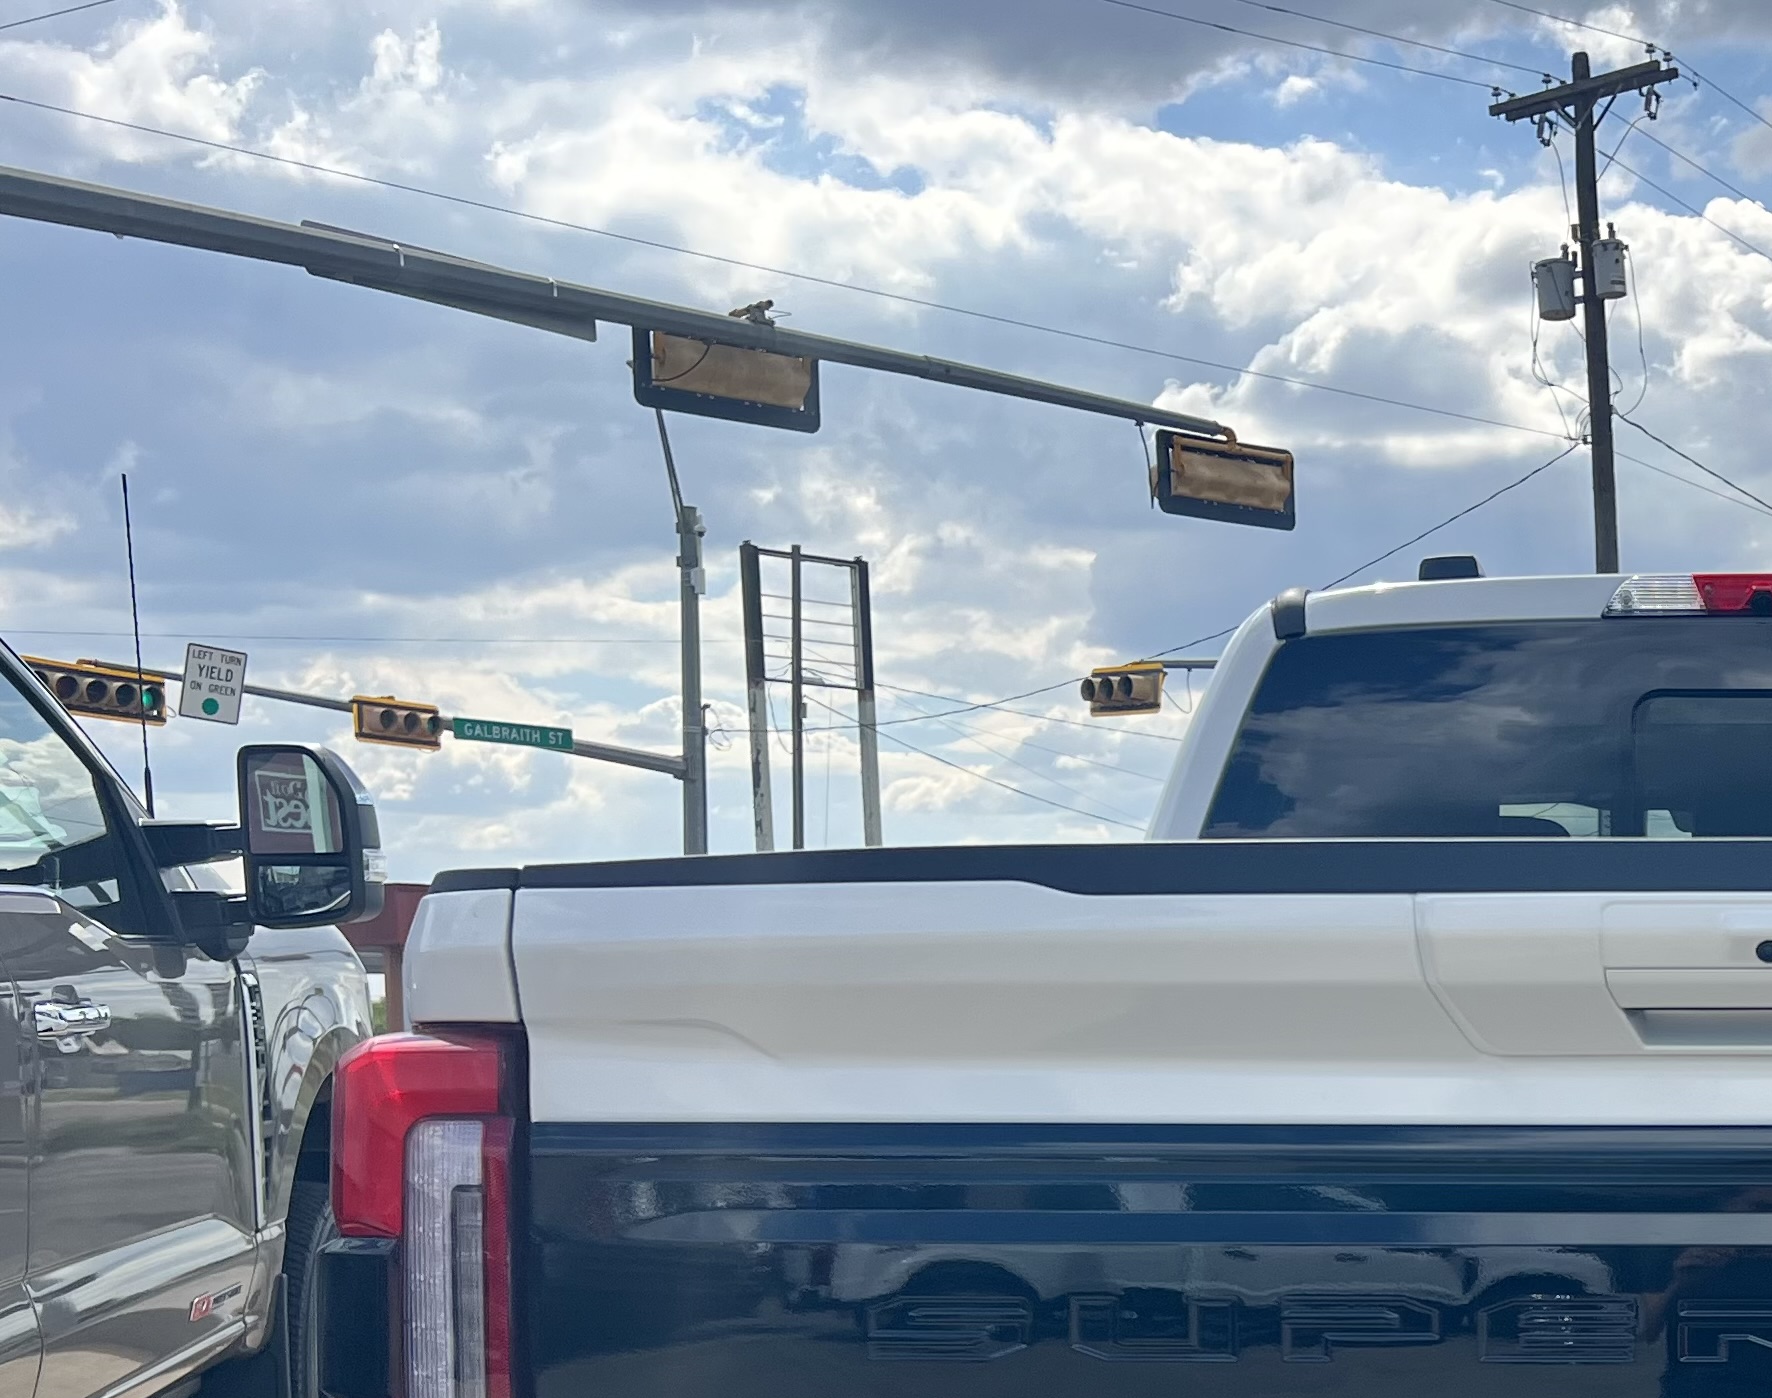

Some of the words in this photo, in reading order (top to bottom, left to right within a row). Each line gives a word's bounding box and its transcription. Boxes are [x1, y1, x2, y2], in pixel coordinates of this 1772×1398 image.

[192, 649, 213, 660] LEFT
[221, 654, 242, 666] TURN
[198, 664, 234, 682] YIELD
[190, 681, 202, 691] ON
[208, 684, 236, 696] GREEN
[464, 723, 541, 743] GALBRAITH
[548, 731, 563, 745] ST
